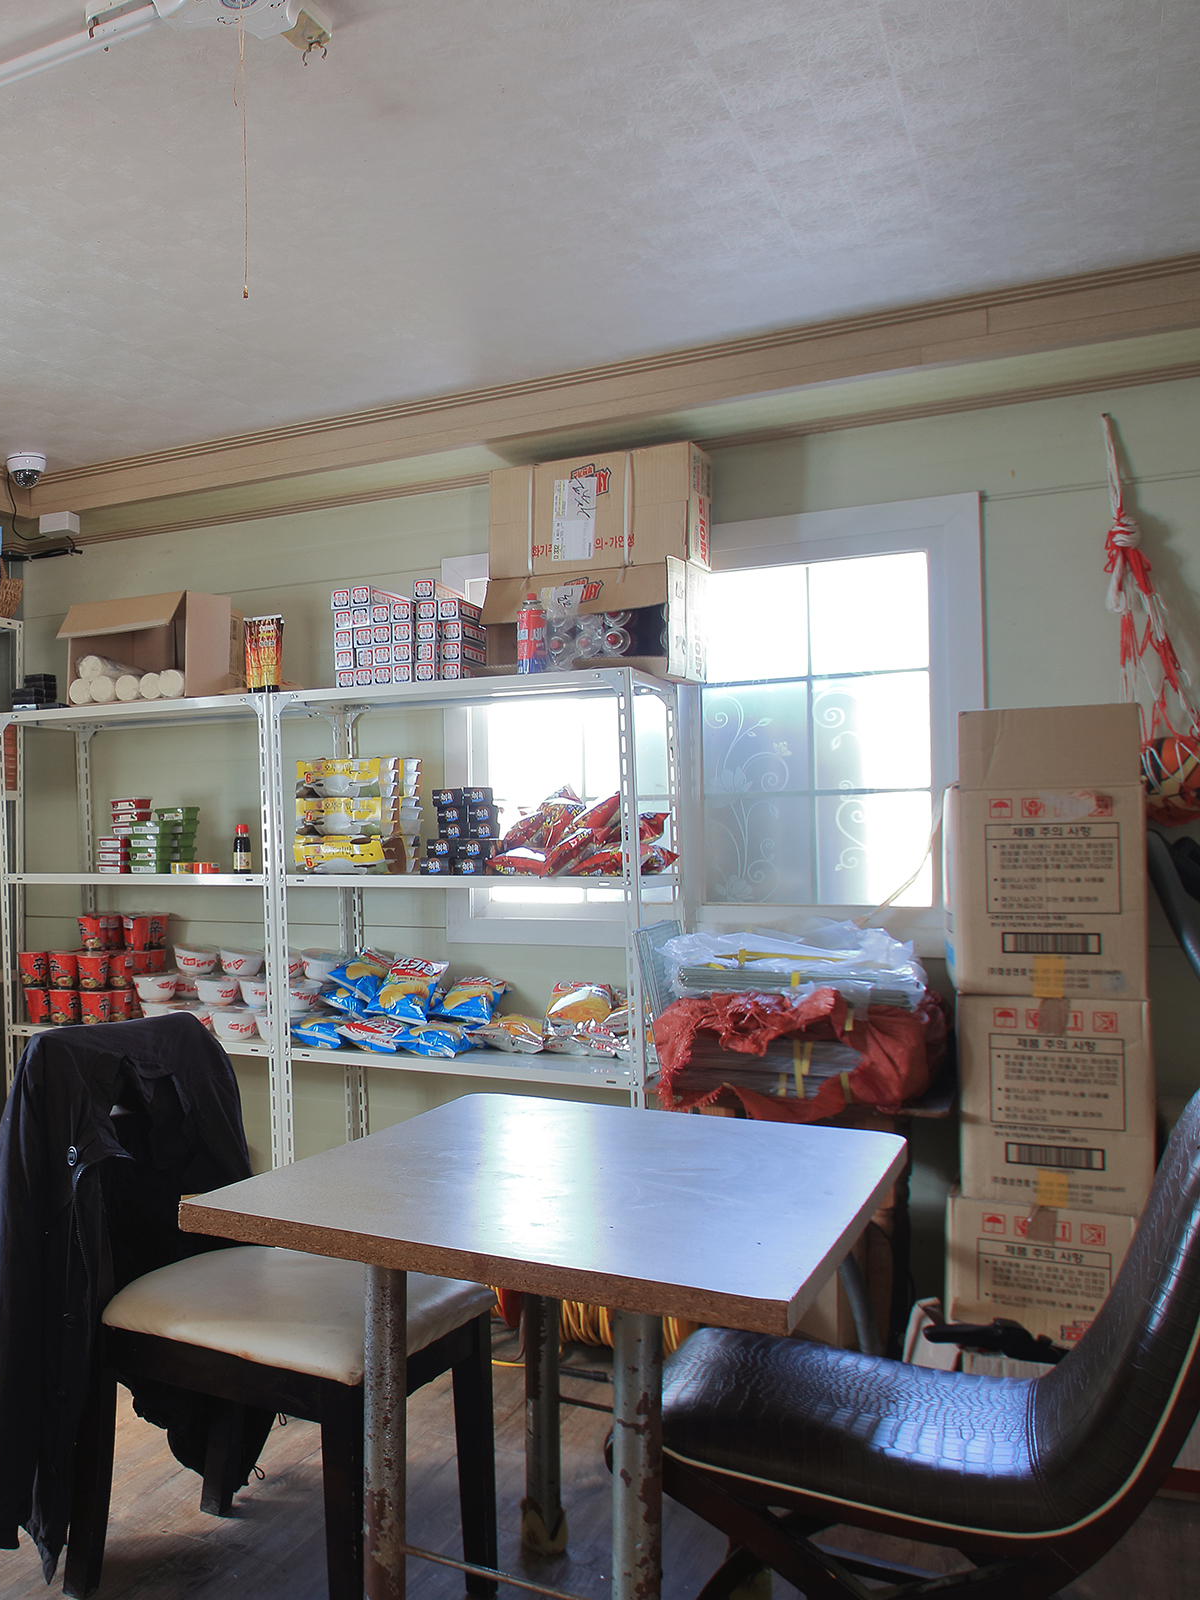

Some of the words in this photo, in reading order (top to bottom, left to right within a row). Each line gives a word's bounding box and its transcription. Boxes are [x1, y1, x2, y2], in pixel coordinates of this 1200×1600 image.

[305, 773, 312, 784] 6
[305, 811, 313, 822] 6
[1012, 826, 1036, 838] 제품
[1040, 826, 1064, 838] 주의
[1067, 825, 1092, 837] 사항
[305, 857, 313, 868] 6
[1016, 1037, 1040, 1049] 제품
[1044, 1038, 1067, 1050] 주의
[1071, 1040, 1096, 1053] 사항
[1004, 1243, 1028, 1257] 제품
[1032, 1247, 1056, 1261] 주의
[1060, 1250, 1084, 1264] 사항
